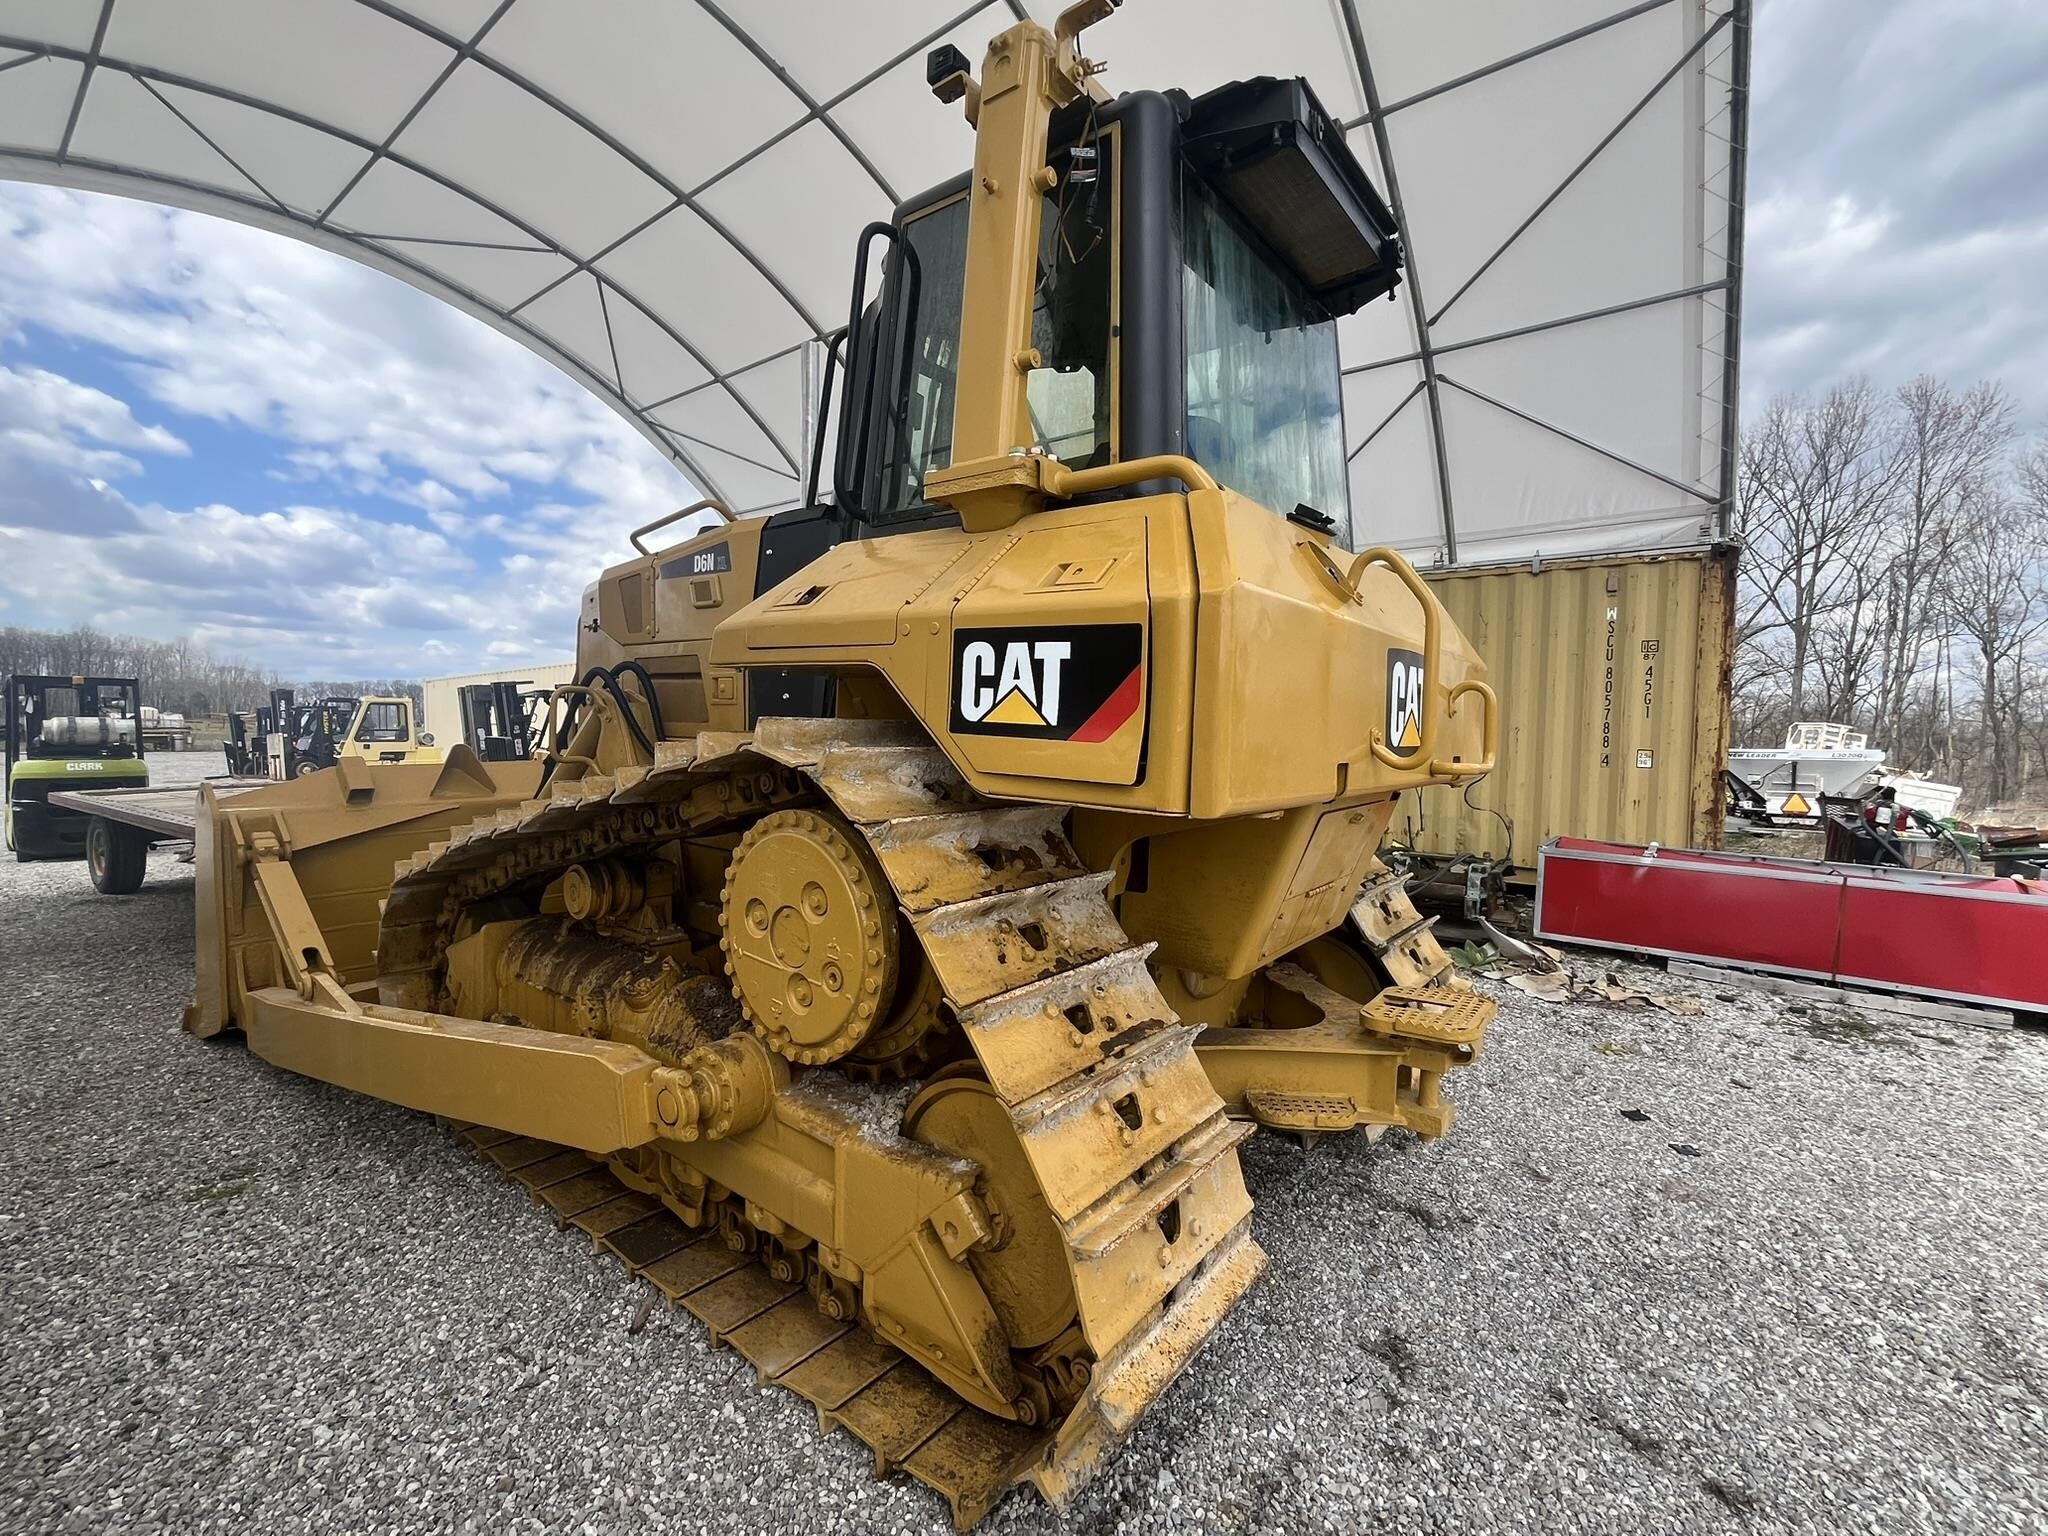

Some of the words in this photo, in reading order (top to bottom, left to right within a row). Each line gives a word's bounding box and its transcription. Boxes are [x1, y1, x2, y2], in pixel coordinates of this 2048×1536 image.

[694, 553, 714, 573] D6N
[1606, 607, 1617, 661] WSCU
[960, 641, 1071, 726] CAT
[1603, 667, 1613, 748] 805788
[1644, 666, 1653, 718] 45G1
[66, 762, 104, 771] CLARK
[1602, 754, 1609, 767] 4
